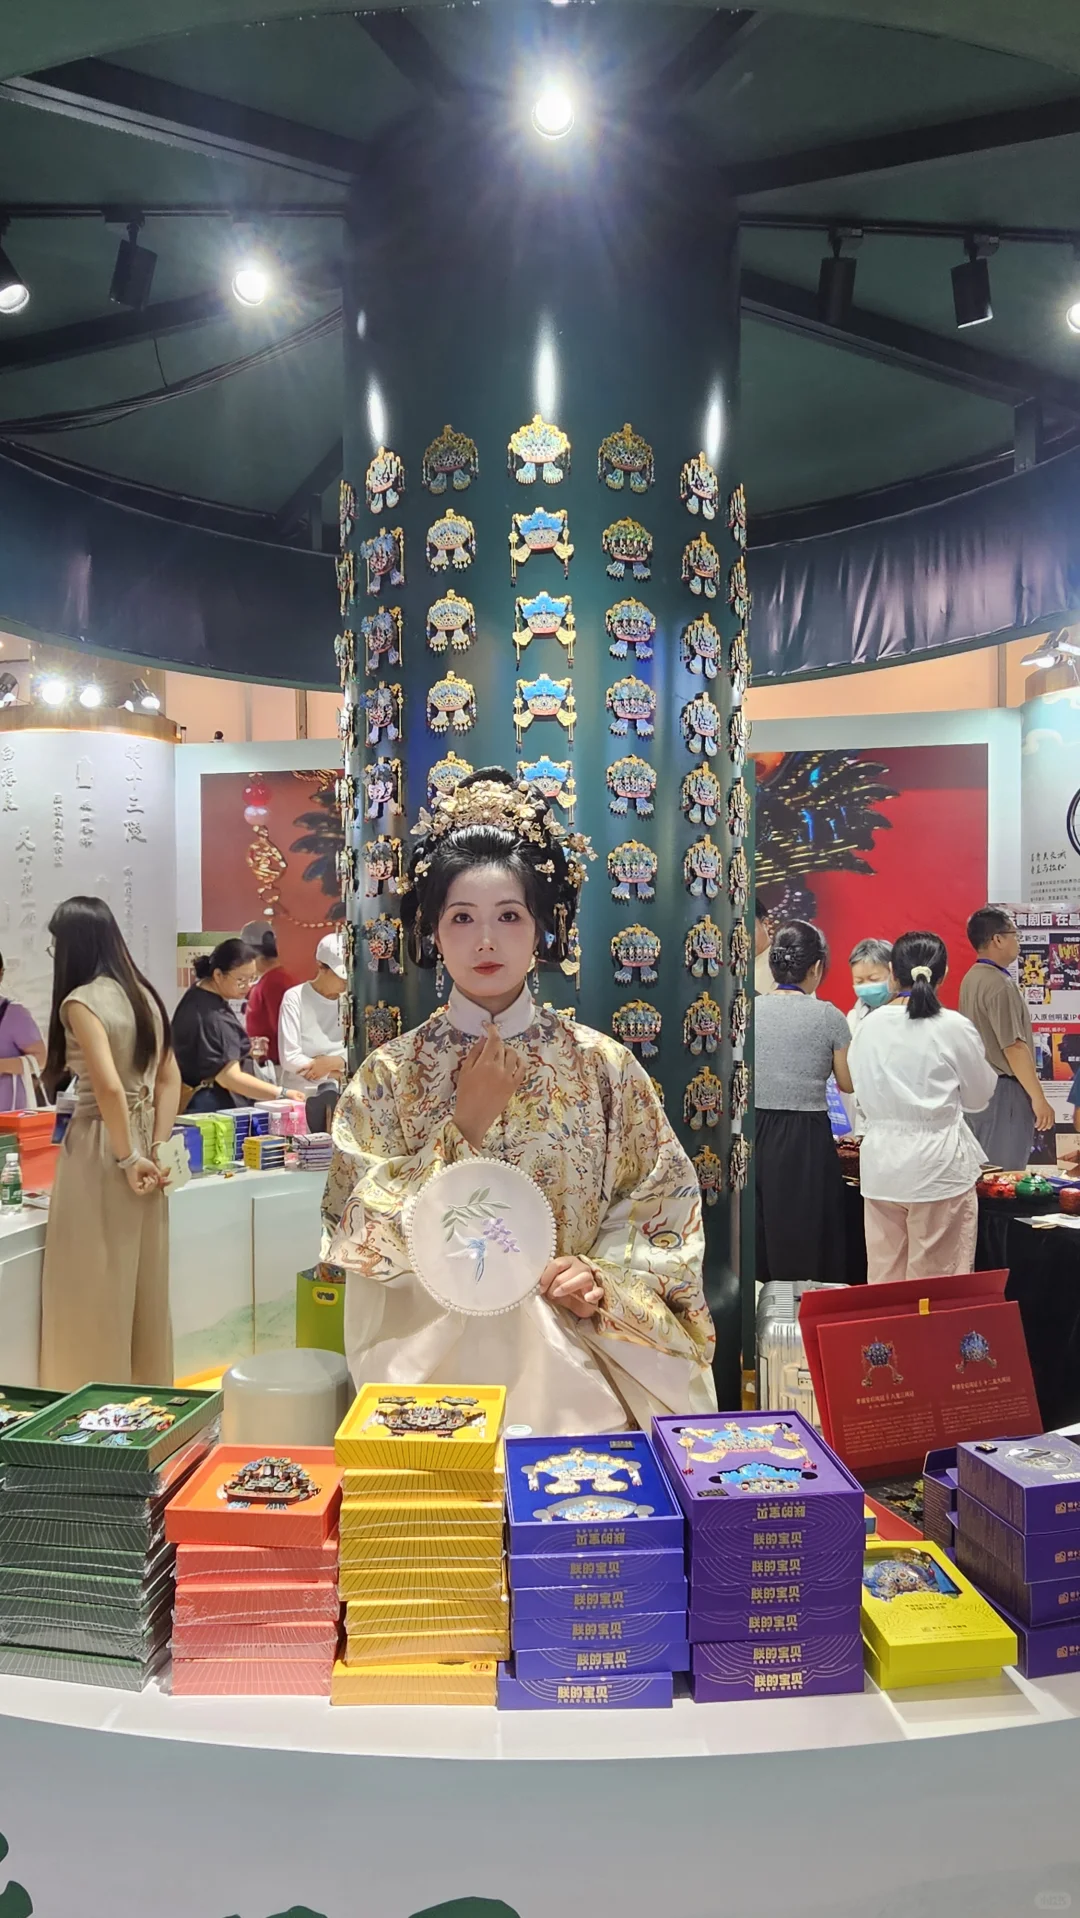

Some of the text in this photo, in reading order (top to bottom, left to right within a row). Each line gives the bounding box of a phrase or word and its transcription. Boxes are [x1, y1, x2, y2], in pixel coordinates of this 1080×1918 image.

[1031, 1013, 1077, 1021] 入原创明星IP
[754, 1532, 802, 1544] 朕的宝贝
[570, 1562, 620, 1575] 朕的宝贝
[752, 1559, 800, 1573] 朕的宝贝
[574, 1591, 624, 1604] 朕的宝贝
[751, 1585, 800, 1600] 朕的宝贝
[749, 1614, 798, 1628] 朕的宝贝
[572, 1622, 622, 1636] 朕的宝贝
[576, 1651, 627, 1667] 朕的宝贝
[753, 1645, 802, 1660] 朕的宝贝
[754, 1673, 803, 1687] 朕的宝贝
[557, 1685, 609, 1699] 朕的宝贝
